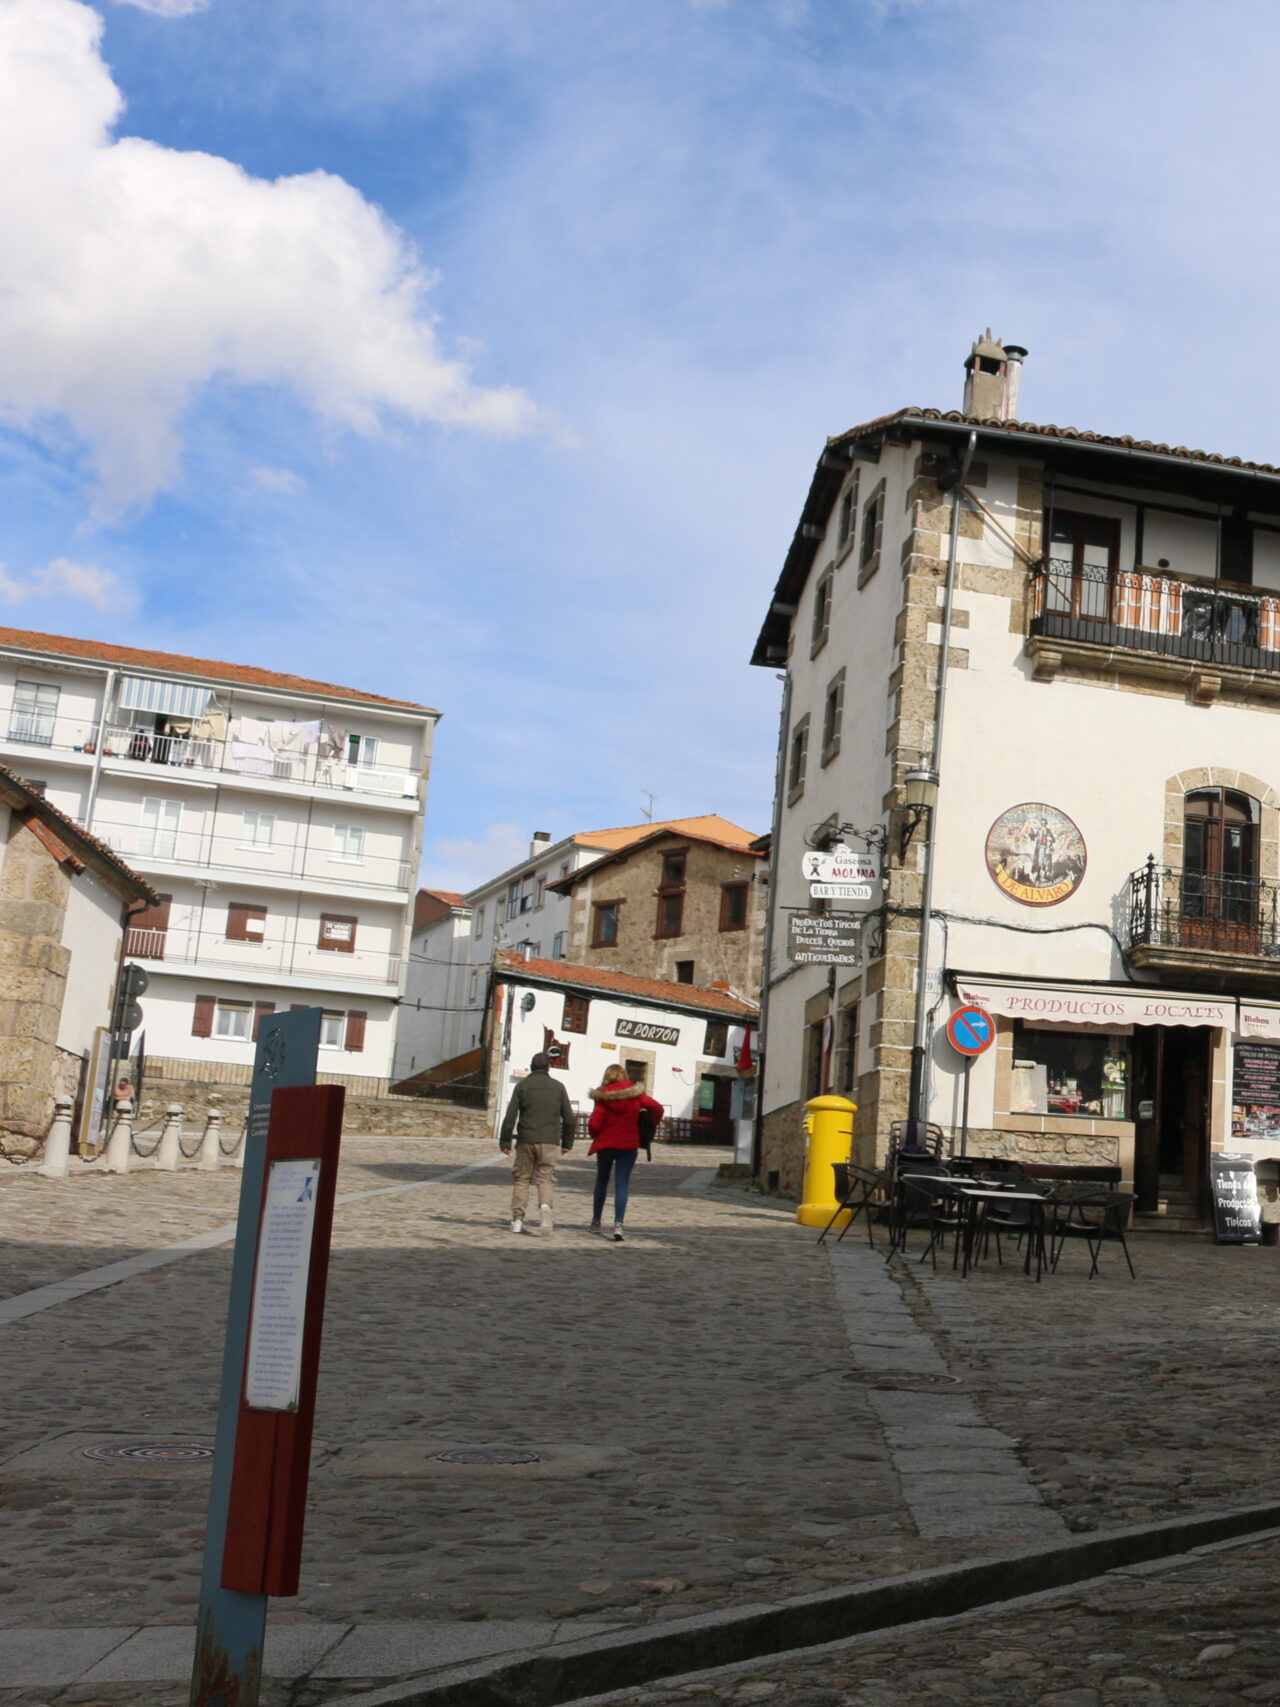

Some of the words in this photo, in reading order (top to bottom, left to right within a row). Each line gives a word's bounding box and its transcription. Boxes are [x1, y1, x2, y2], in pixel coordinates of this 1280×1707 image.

[834, 856, 872, 866] Gaseosa
[831, 867, 876, 879] MOLINA
[813, 886, 828, 896] BAR
[829, 886, 836, 896] Y
[839, 887, 869, 897] TIENDA
[1001, 876, 1020, 895] DE
[1020, 881, 1070, 901] ALVARO
[1006, 996, 1125, 1016] PRODUCTOS
[1143, 1004, 1225, 1019] LOCALES
[1244, 1014, 1270, 1025] Mahou
[617, 1021, 632, 1035] EL
[1216, 1179, 1242, 1190] Tienda
